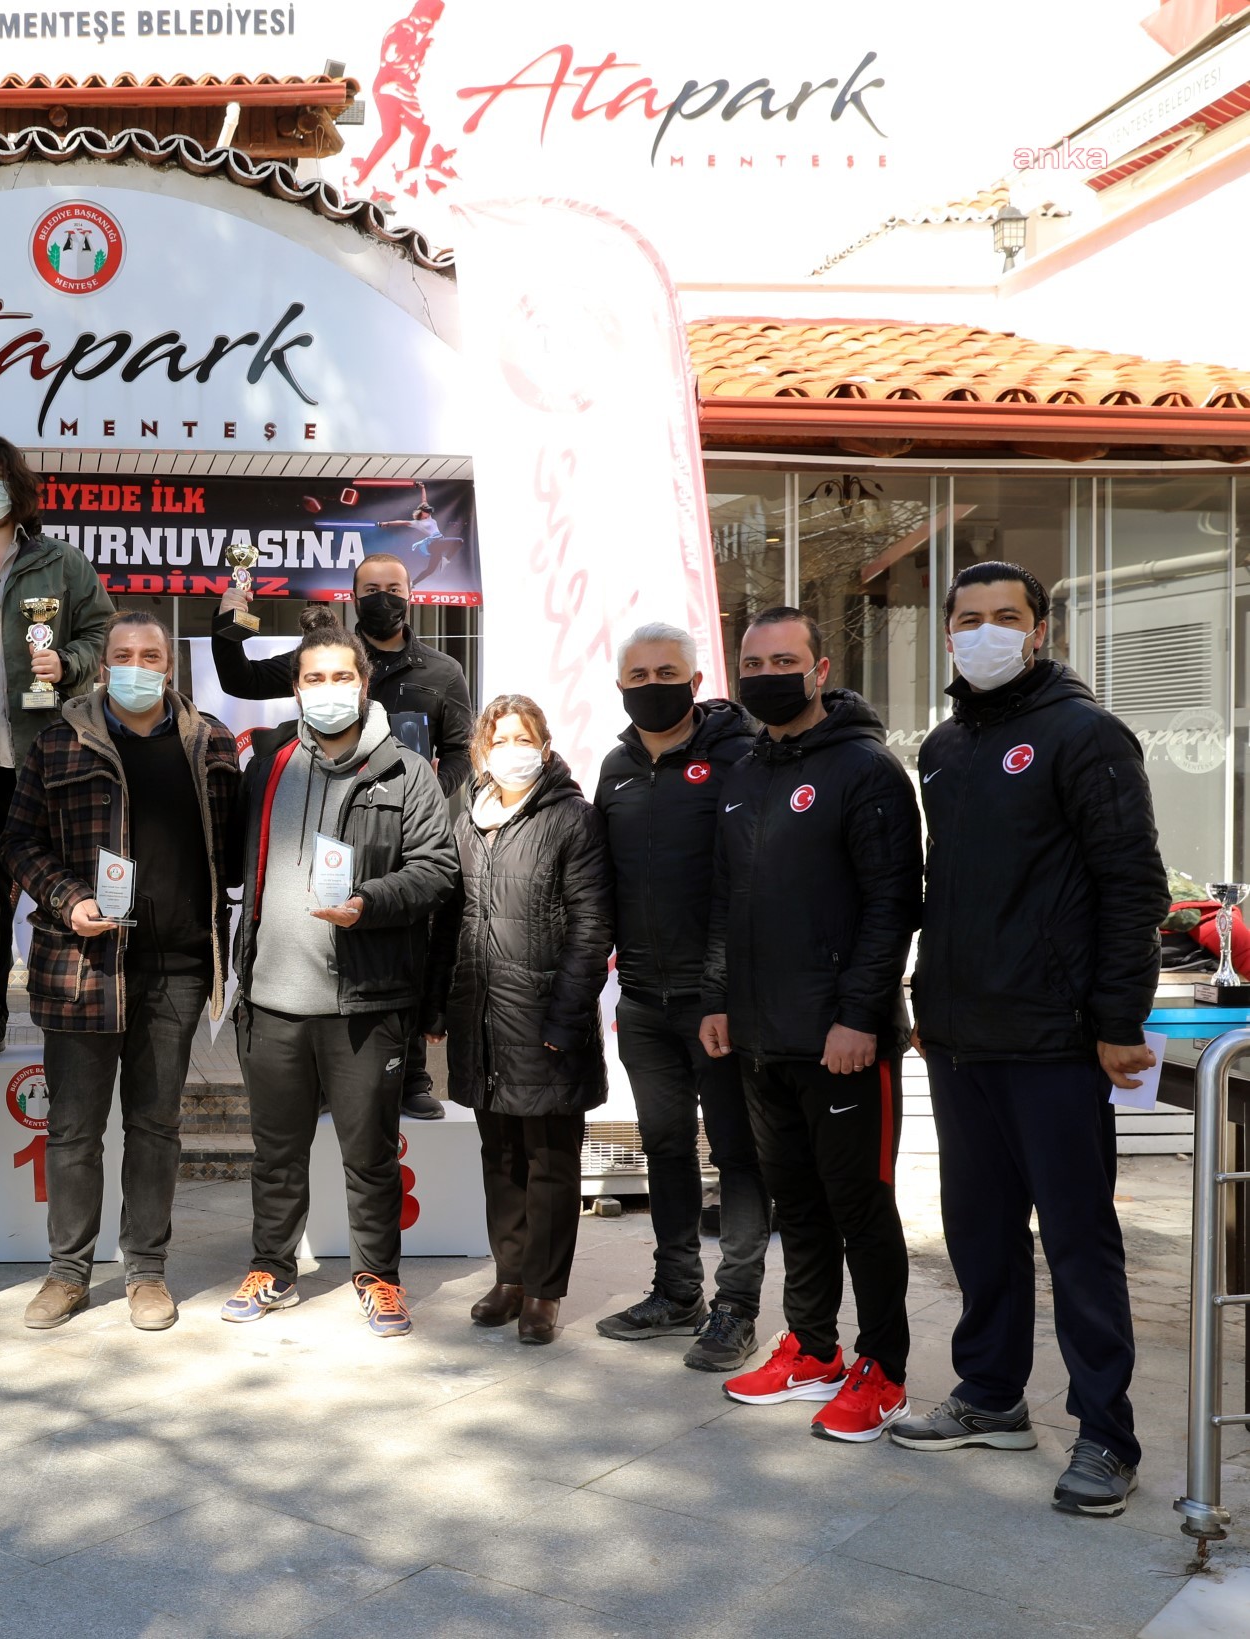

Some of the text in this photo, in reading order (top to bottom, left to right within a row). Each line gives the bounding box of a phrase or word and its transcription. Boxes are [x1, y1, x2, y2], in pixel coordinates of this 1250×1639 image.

[137, 3, 295, 36] BELEDİYESİ
[456, 44, 888, 168] Atapark
[38, 208, 117, 243] BELEDİYE BAŞKANLIĞI
[54, 277, 99, 290] MENTEŞE
[59, 418, 318, 441] MENTEŞE
[151, 479, 205, 514] İLK
[431, 595, 467, 604] 2021
[10, 1069, 35, 1092] BELEDİYE
[13, 1135, 49, 1202] 1
